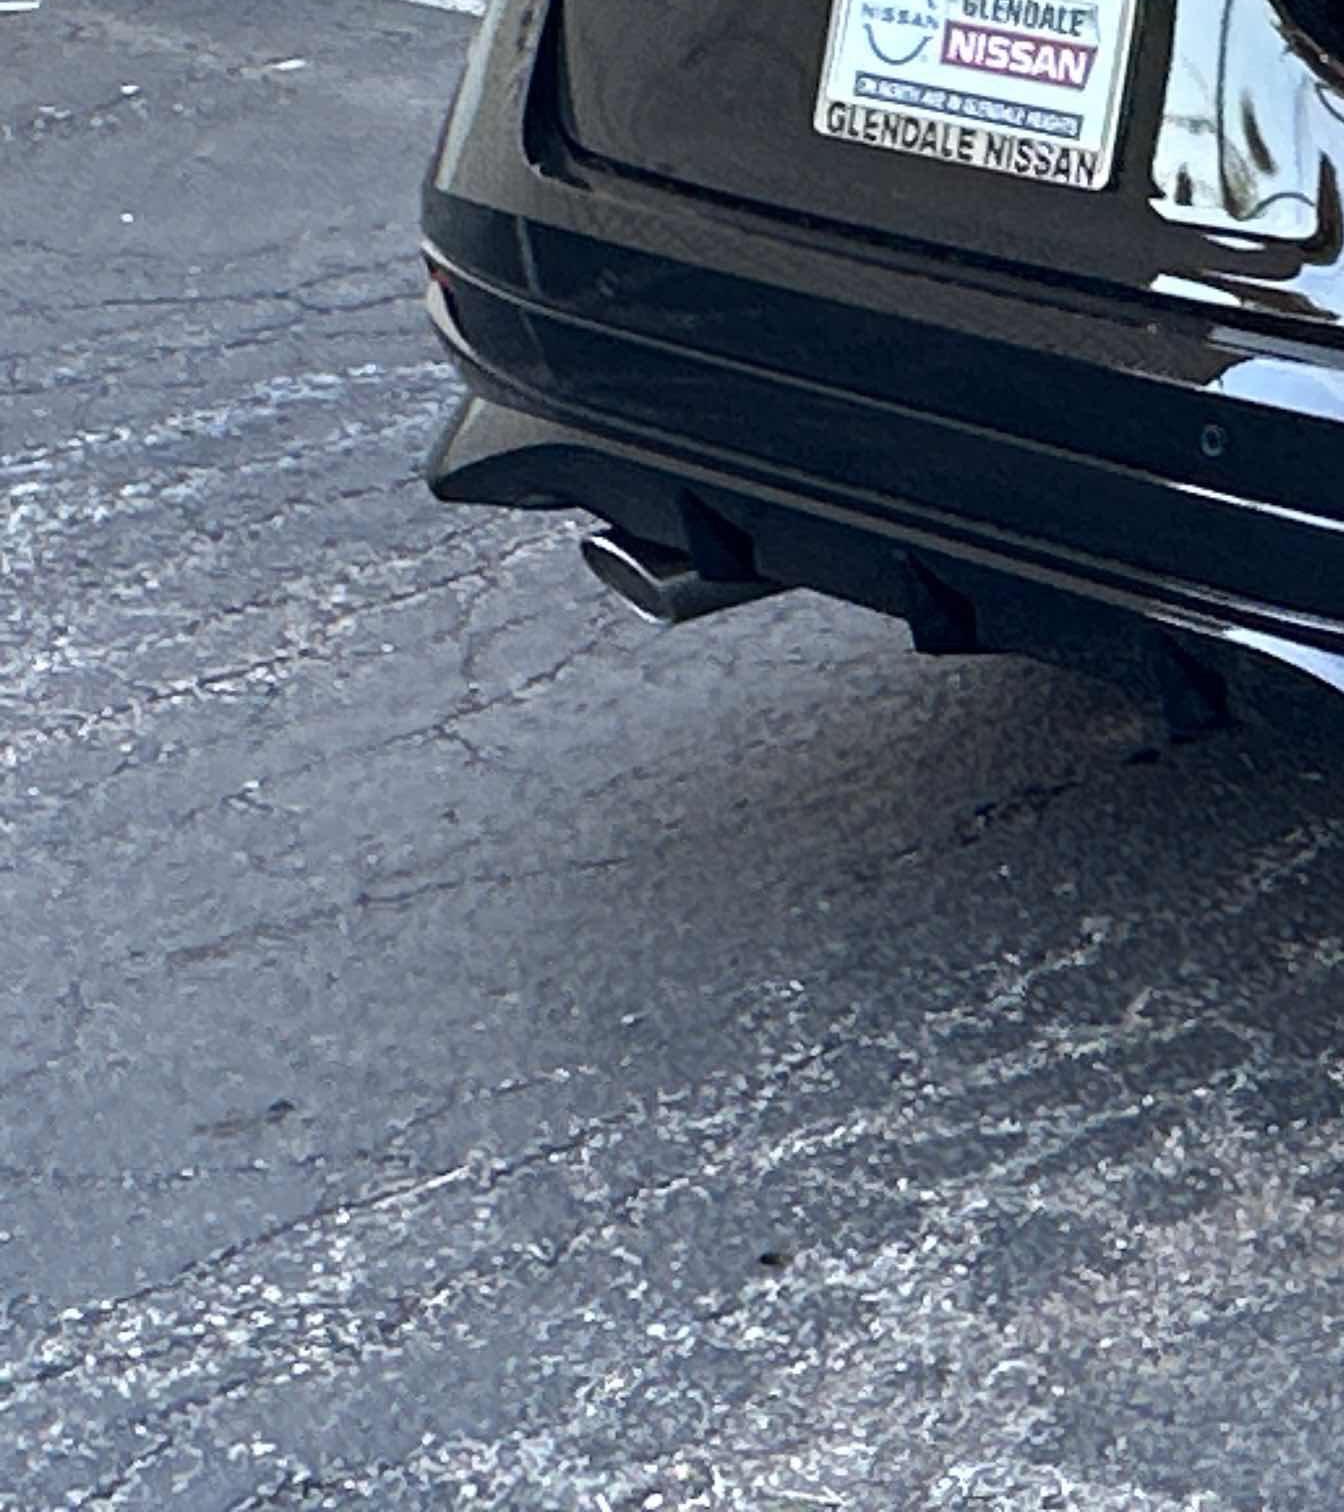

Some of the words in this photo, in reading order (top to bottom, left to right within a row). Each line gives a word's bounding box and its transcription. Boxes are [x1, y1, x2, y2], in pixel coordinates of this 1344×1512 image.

[861, 2, 939, 29] NISSAN
[947, 29, 1088, 84] NISSAN
[825, 101, 975, 162] GLENDALE
[983, 131, 1100, 186] NISSAN
